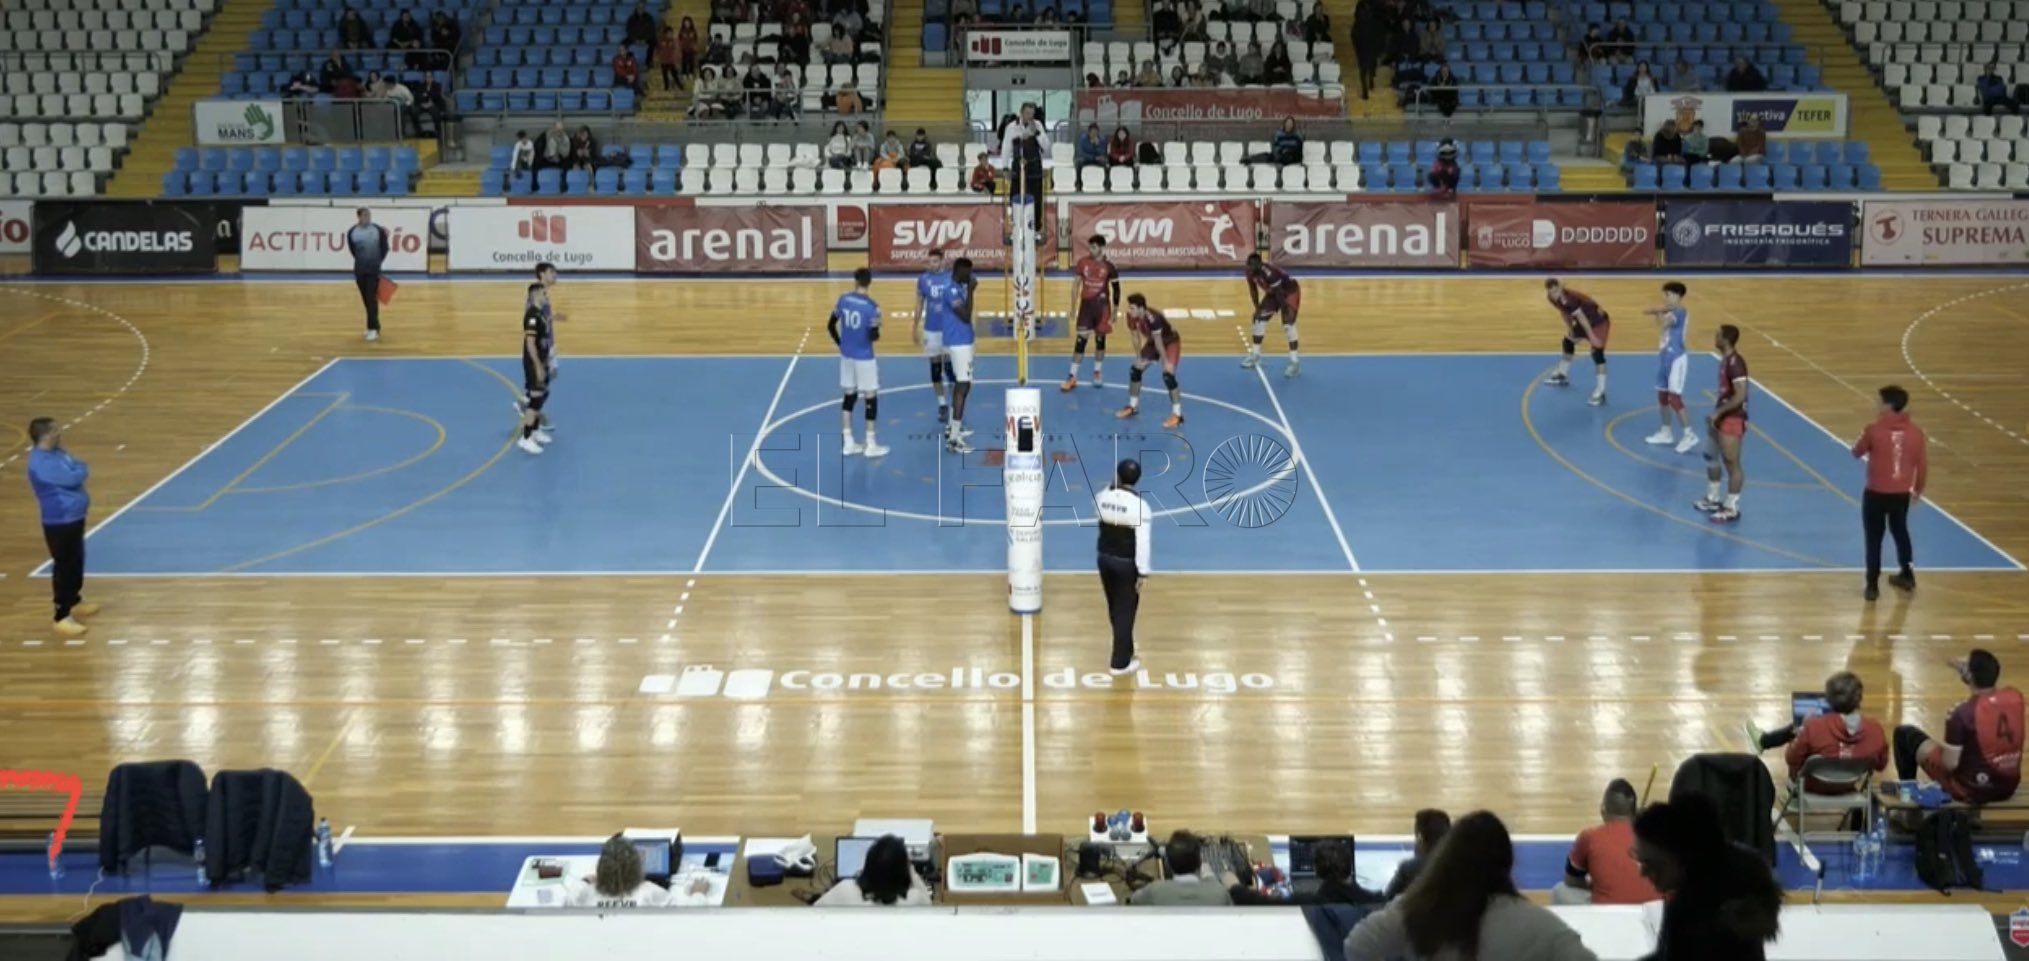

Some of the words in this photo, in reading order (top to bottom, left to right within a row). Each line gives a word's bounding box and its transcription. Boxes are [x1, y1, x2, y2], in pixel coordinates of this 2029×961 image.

[1004, 38, 1036, 46] Concello
[1037, 38, 1047, 46] de
[1146, 104, 1203, 119] Concello
[1207, 104, 1225, 119] de
[1229, 105, 1263, 121] Lugo
[1797, 109, 1831, 121] TEFER
[217, 128, 256, 139] MANS
[1912, 209, 1970, 221] TERNERA
[650, 215, 813, 261] arenal
[892, 219, 974, 247] SVM
[1095, 217, 1174, 245] SVM
[1282, 211, 1447, 256] arenal
[1704, 221, 1844, 237] FRISAQUÉS
[1922, 226, 2026, 245] SUPREMA
[84, 230, 194, 252] CANDELAS
[249, 231, 346, 252] ACTITU
[492, 251, 542, 263] Concello
[546, 251, 561, 263] de
[564, 252, 593, 266] Lugo
[842, 309, 862, 330] 10
[779, 666, 1021, 690] Concello
[1042, 666, 1114, 689] de
[1135, 667, 1275, 694] Lugo
[1996, 711, 2014, 745] 4
